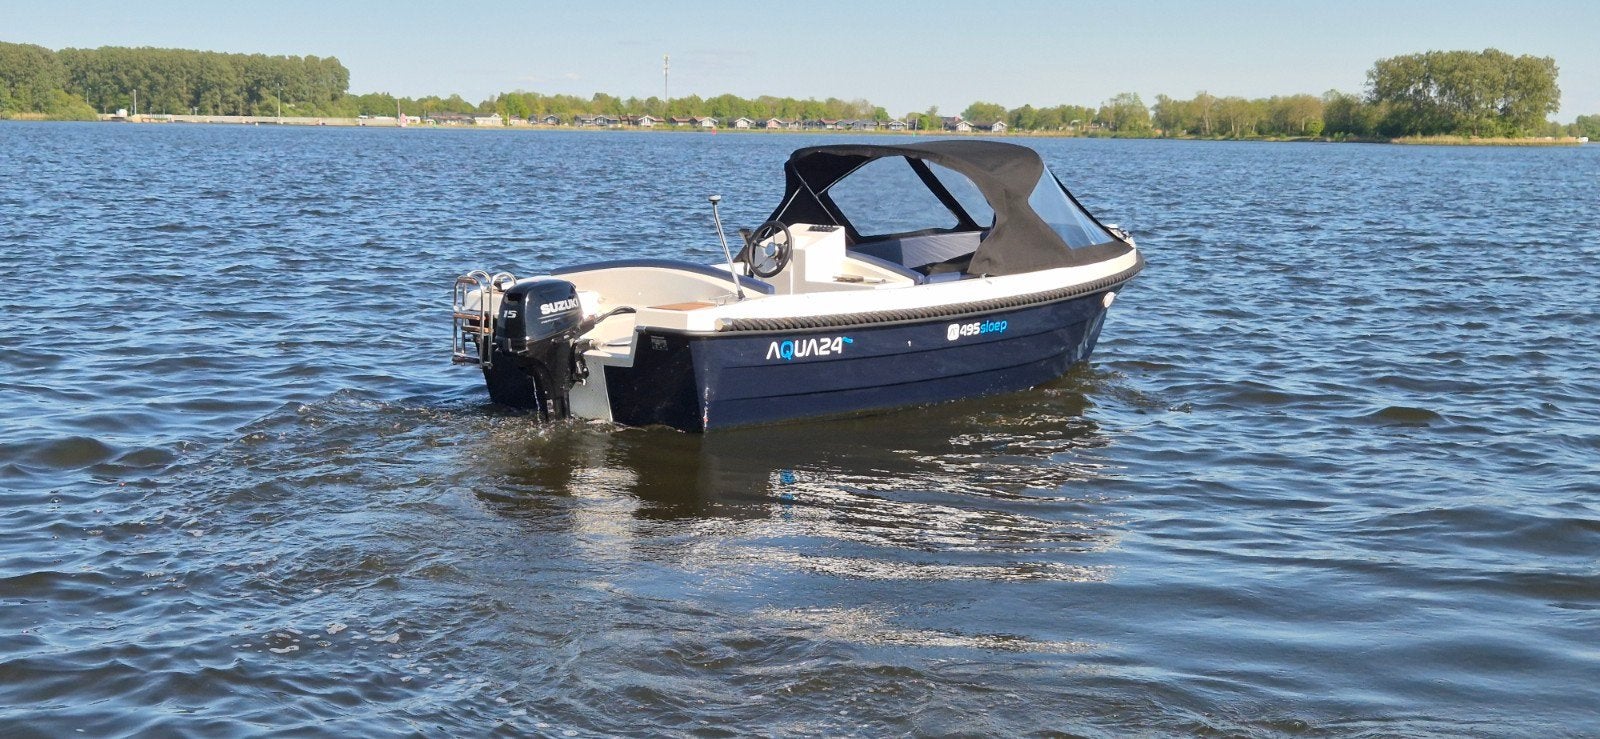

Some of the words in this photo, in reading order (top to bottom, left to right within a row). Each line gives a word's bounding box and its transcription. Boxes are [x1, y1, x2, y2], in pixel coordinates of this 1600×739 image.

[503, 310, 518, 318] 15
[540, 298, 578, 315] SUZUKI
[766, 337, 842, 359] AQUA24
